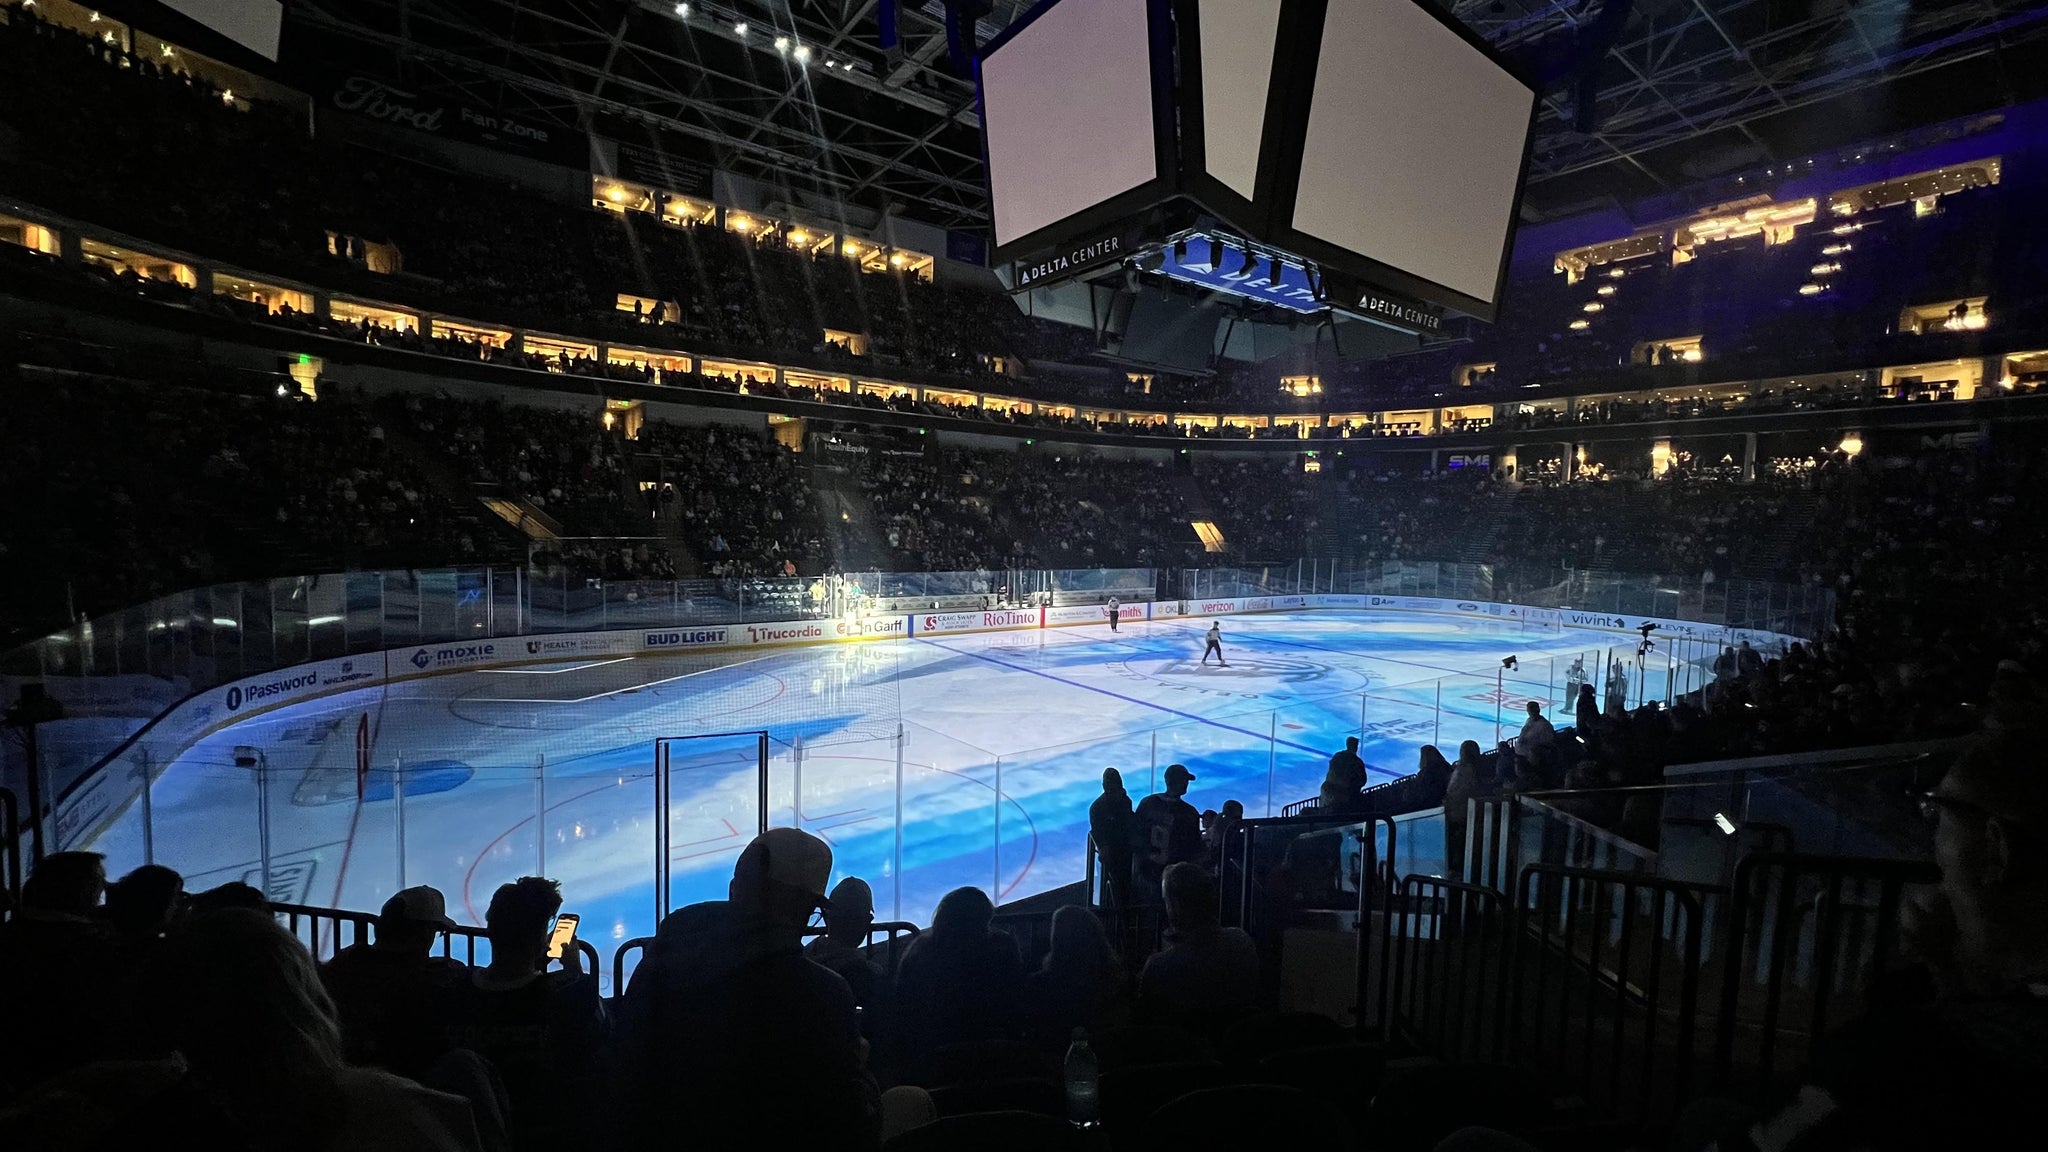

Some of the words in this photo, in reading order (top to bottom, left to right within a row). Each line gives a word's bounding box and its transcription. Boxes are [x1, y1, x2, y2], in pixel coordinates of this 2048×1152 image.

[333, 76, 446, 132] Ford
[460, 106, 498, 129] Fan
[501, 117, 550, 143] Zone
[1031, 256, 1069, 280] DELTA
[1071, 236, 1119, 265] CENTER
[1369, 297, 1403, 318] DELTA
[1404, 308, 1440, 329] CENTER
[1118, 606, 1142, 618] mith's
[1201, 600, 1234, 613] verizon
[937, 614, 956, 622] CRAIG
[1572, 613, 1612, 627] vivint
[759, 625, 822, 640] Trucordia
[874, 619, 902, 633] Garff
[543, 640, 577, 650] HEALTH
[647, 633, 680, 645] BUD
[682, 630, 726, 643] LIGHT
[437, 644, 495, 660] moxie
